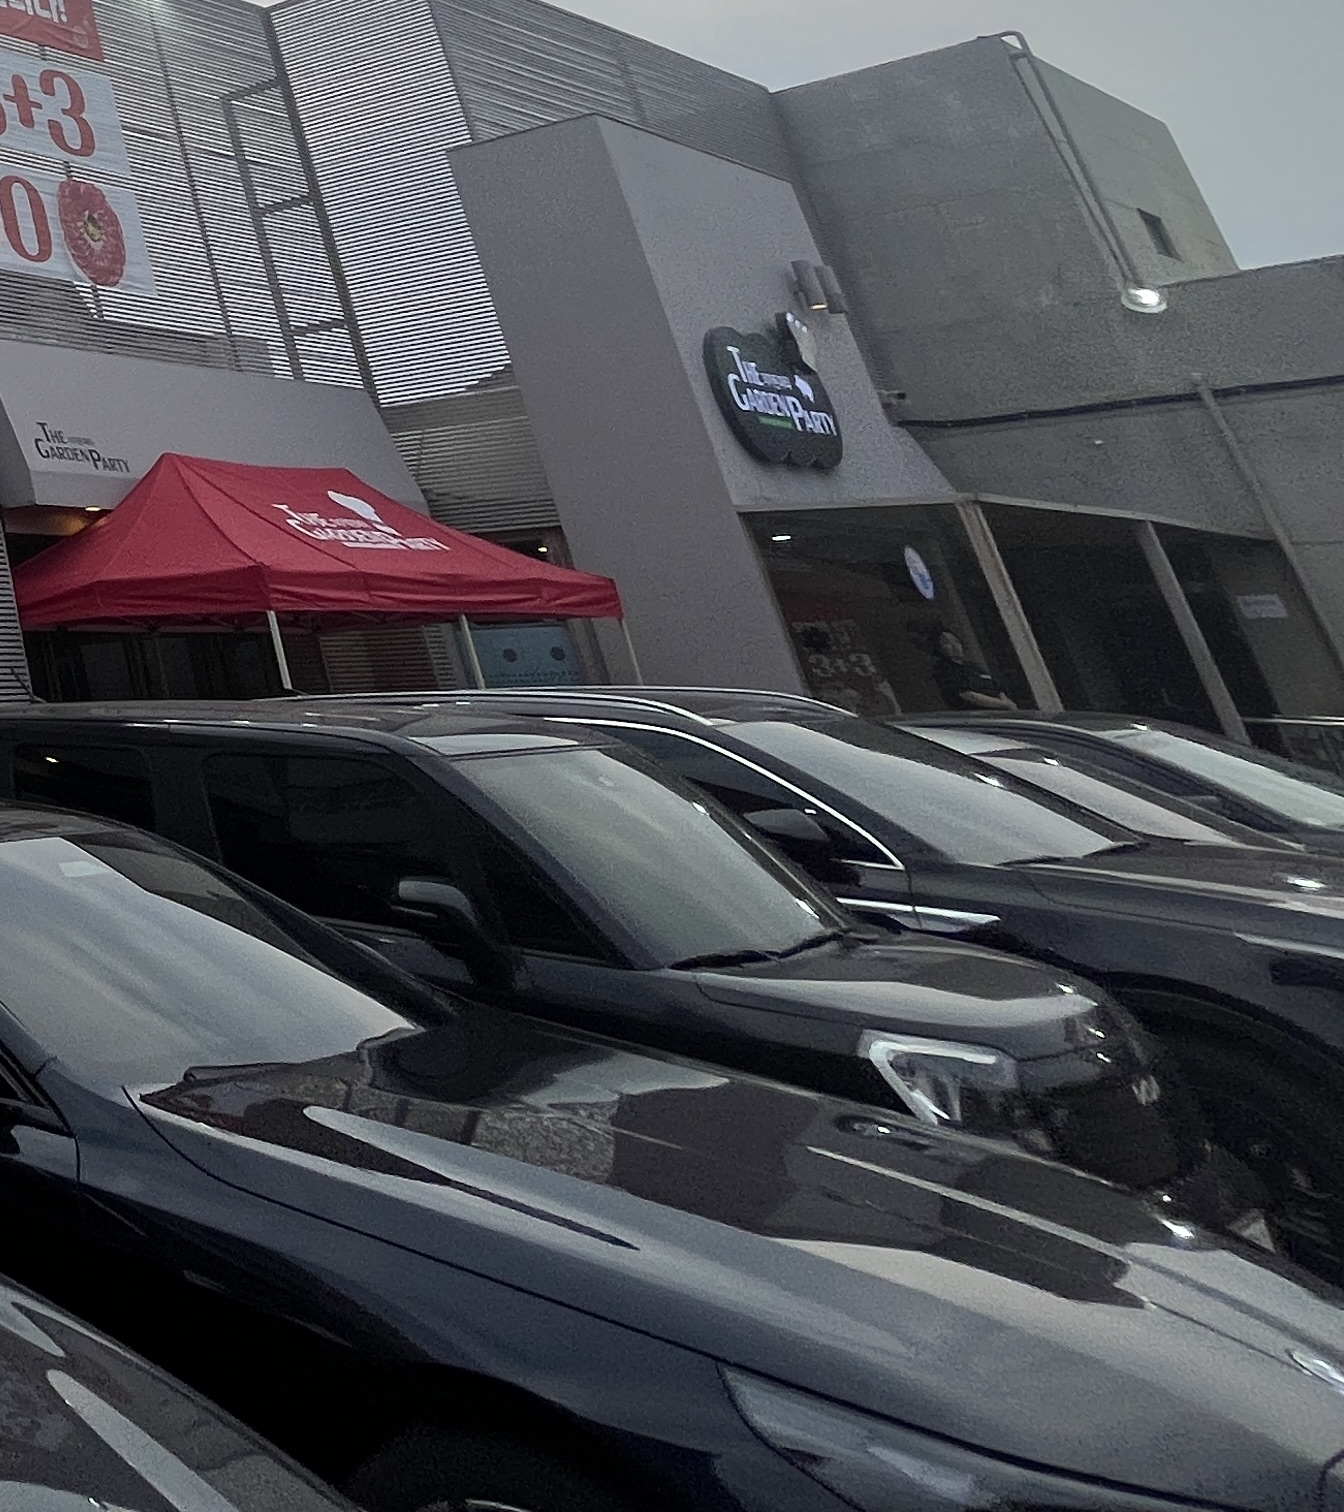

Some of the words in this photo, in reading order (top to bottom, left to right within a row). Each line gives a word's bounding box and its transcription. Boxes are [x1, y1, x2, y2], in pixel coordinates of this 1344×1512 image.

[36, 421, 67, 444] THE
[34, 438, 90, 463] GARDEN
[88, 449, 130, 473] PARTY
